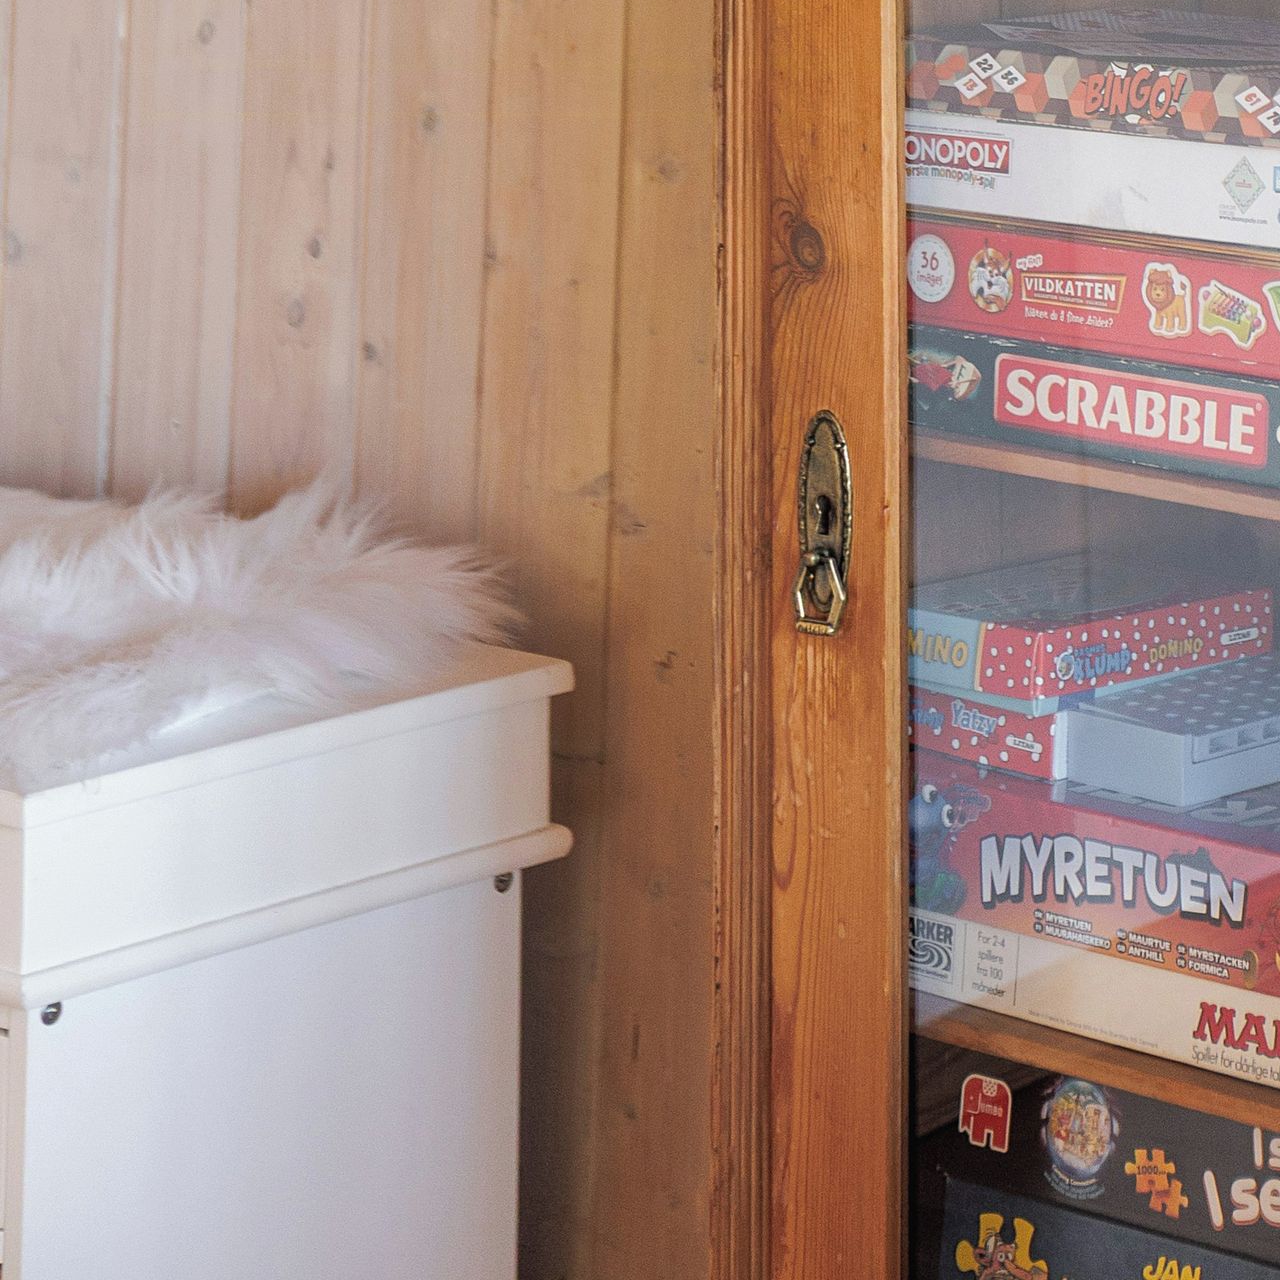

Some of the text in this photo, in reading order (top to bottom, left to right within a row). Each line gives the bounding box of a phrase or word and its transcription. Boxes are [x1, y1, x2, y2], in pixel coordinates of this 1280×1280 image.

[976, 58, 995, 75] 22
[1000, 71, 1019, 87] 36
[1084, 68, 1188, 119] BINGO!
[904, 134, 1009, 170] ONOPOLY
[916, 270, 943, 288] images
[921, 251, 940, 271] 36
[1024, 277, 1117, 302] VILDKATTEN
[1004, 369, 1257, 455] SCRABBLE
[907, 628, 969, 668] MINO
[1150, 638, 1204, 665] DOMINO
[952, 700, 997, 736] Yatzy
[981, 836, 1246, 923] MYRETUEN
[908, 917, 953, 945] ARKER
[1045, 913, 1092, 931] MYRETUEN
[1128, 933, 1171, 951] MAURTUE
[1189, 947, 1250, 971] MYRSTACKEN
[1128, 946, 1165, 963] ANTHILL
[1188, 960, 1230, 979] FORMICA
[1191, 1044, 1219, 1066] Spillet
[1219, 1047, 1235, 1068] for
[1234, 1052, 1268, 1080] dårlige
[1252, 1126, 1263, 1170] I
[1203, 1169, 1224, 1232] I
[1142, 1255, 1201, 1280] JAN
